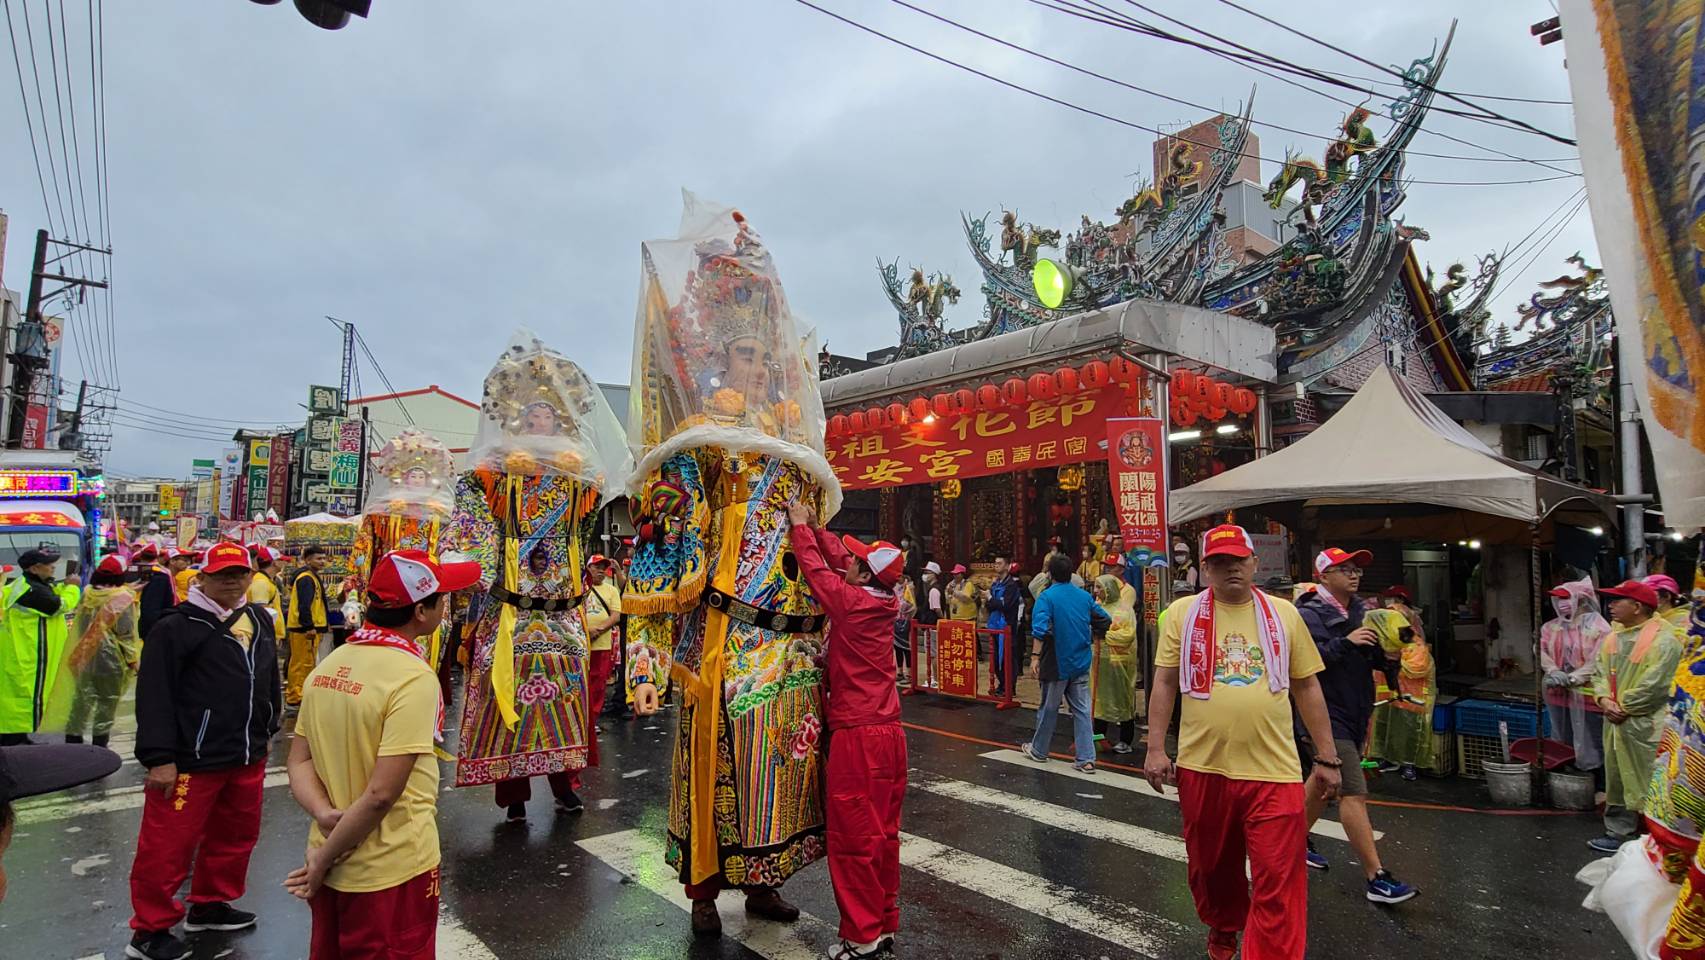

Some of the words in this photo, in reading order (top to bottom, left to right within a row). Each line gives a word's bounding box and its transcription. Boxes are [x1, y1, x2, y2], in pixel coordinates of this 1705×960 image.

[1119, 472, 1156, 492] 蘭陽
[1120, 492, 1157, 512] 媽祖
[1121, 512, 1158, 526] 文化節
[951, 626, 965, 688] 請勿停車
